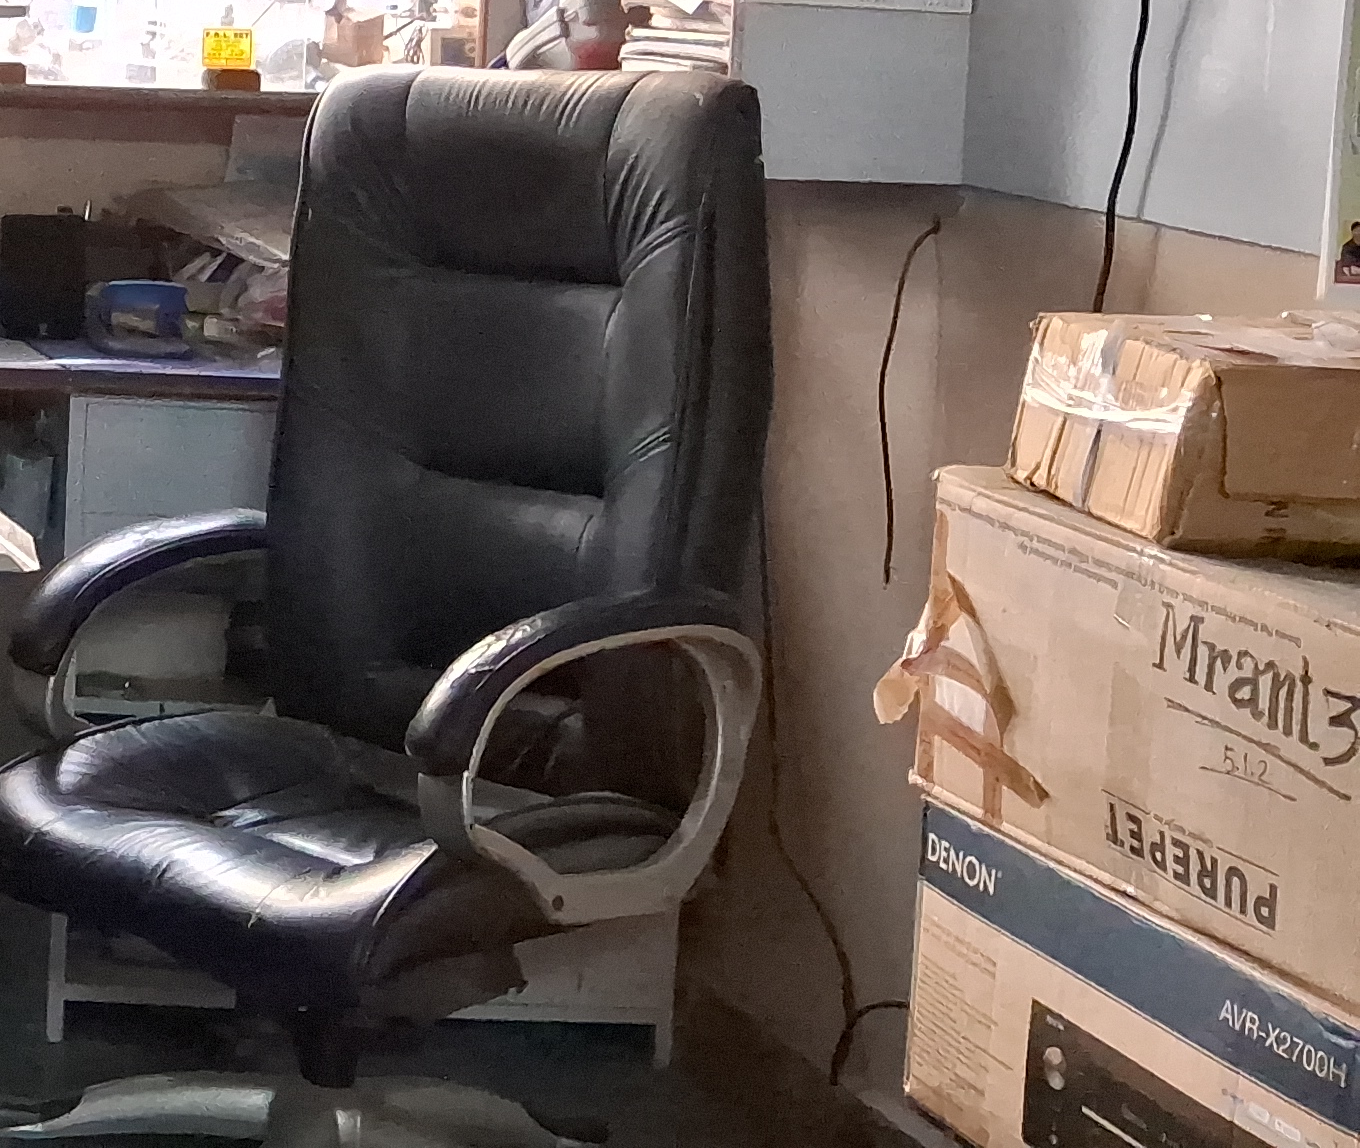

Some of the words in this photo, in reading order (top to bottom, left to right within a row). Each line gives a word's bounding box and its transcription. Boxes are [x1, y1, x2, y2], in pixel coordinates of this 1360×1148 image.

[926, 831, 997, 897] DENON
[1105, 802, 1279, 932] PUREPET
[1218, 998, 1348, 1089] AVR-X2700H
